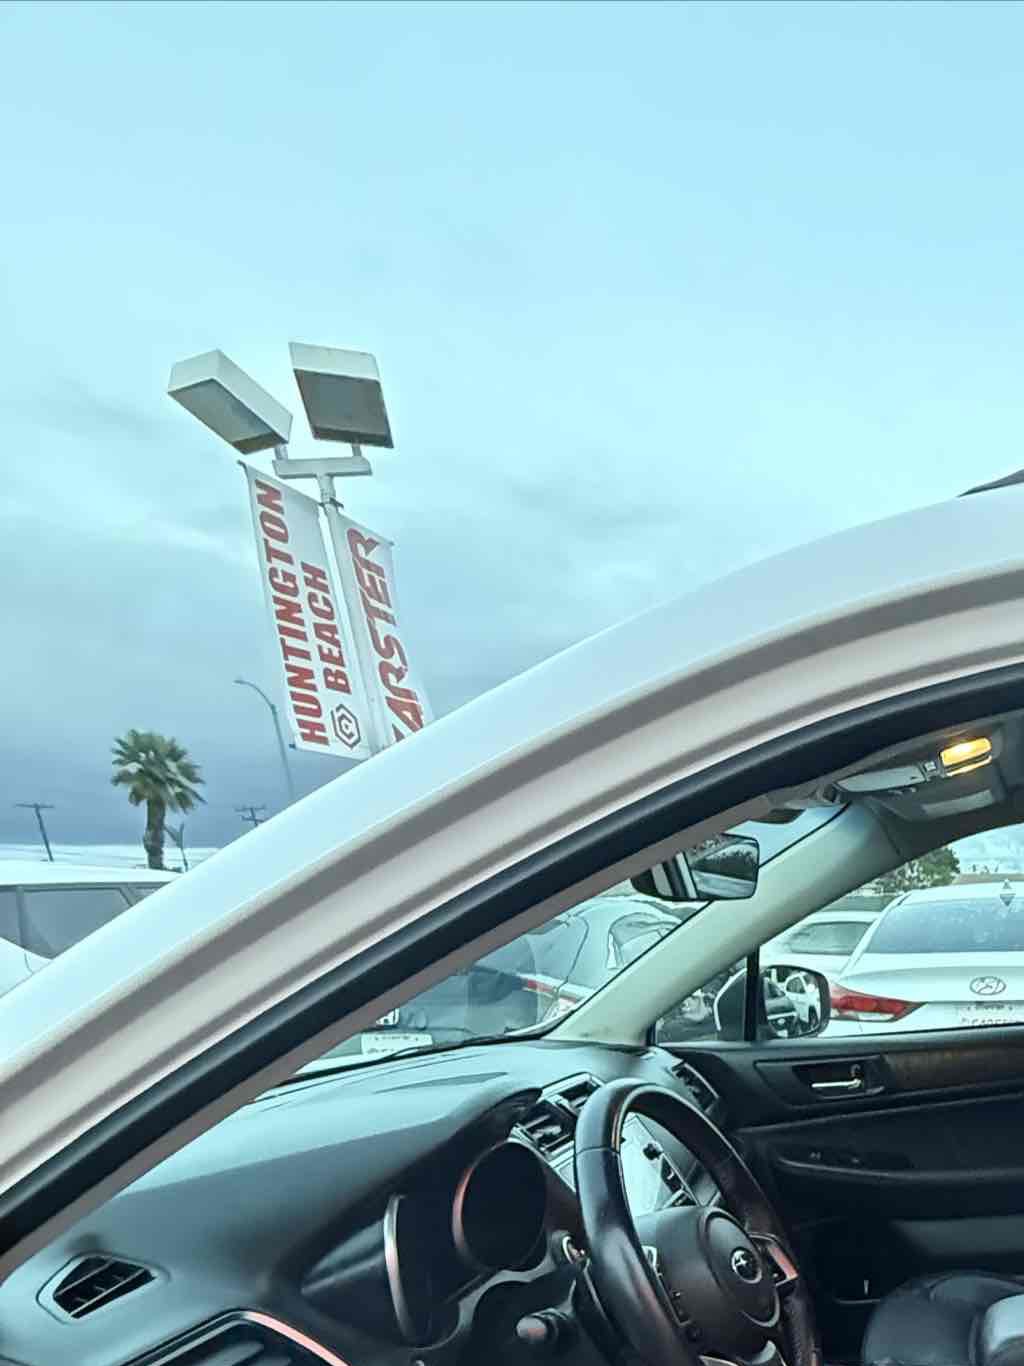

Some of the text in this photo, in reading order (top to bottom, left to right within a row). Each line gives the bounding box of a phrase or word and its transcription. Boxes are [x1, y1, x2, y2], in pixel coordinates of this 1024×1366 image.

[255, 480, 329, 746] HUNTINGTON
[301, 562, 352, 695] BEACH
[347, 528, 424, 743] ARSTER
